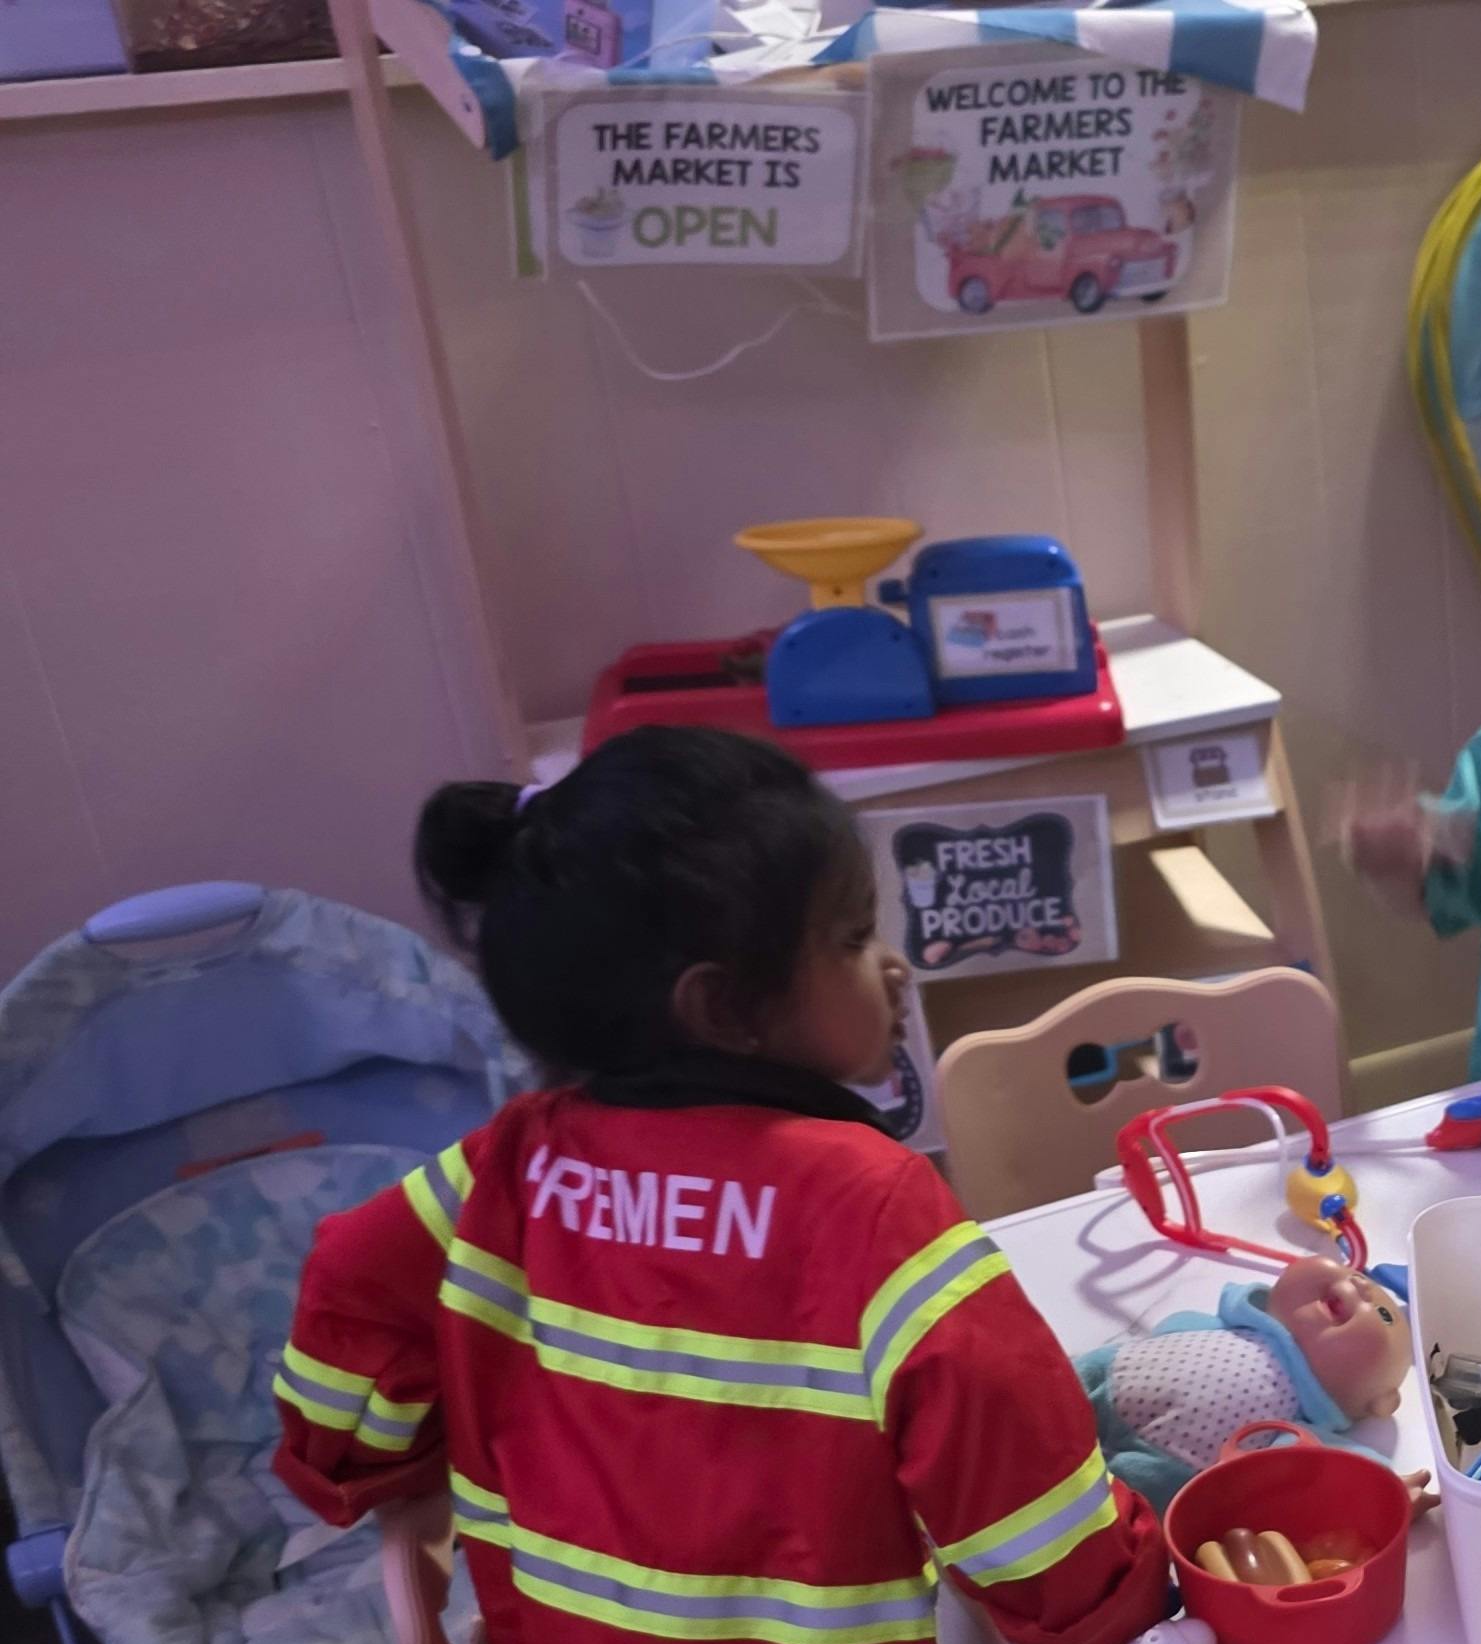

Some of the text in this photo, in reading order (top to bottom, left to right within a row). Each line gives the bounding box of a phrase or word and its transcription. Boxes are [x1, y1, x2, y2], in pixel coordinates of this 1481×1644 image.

[926, 69, 1187, 112] WELCOME TO THE
[593, 122, 821, 154] THE FARMERS
[980, 107, 1133, 147] FARMERS
[612, 158, 801, 188] MARKET IS
[988, 146, 1124, 184] MARKET
[632, 205, 778, 248] OPEN
[935, 835, 1032, 871] FRESH
[946, 867, 1037, 907] Local
[920, 896, 1063, 940] PRODUCE
